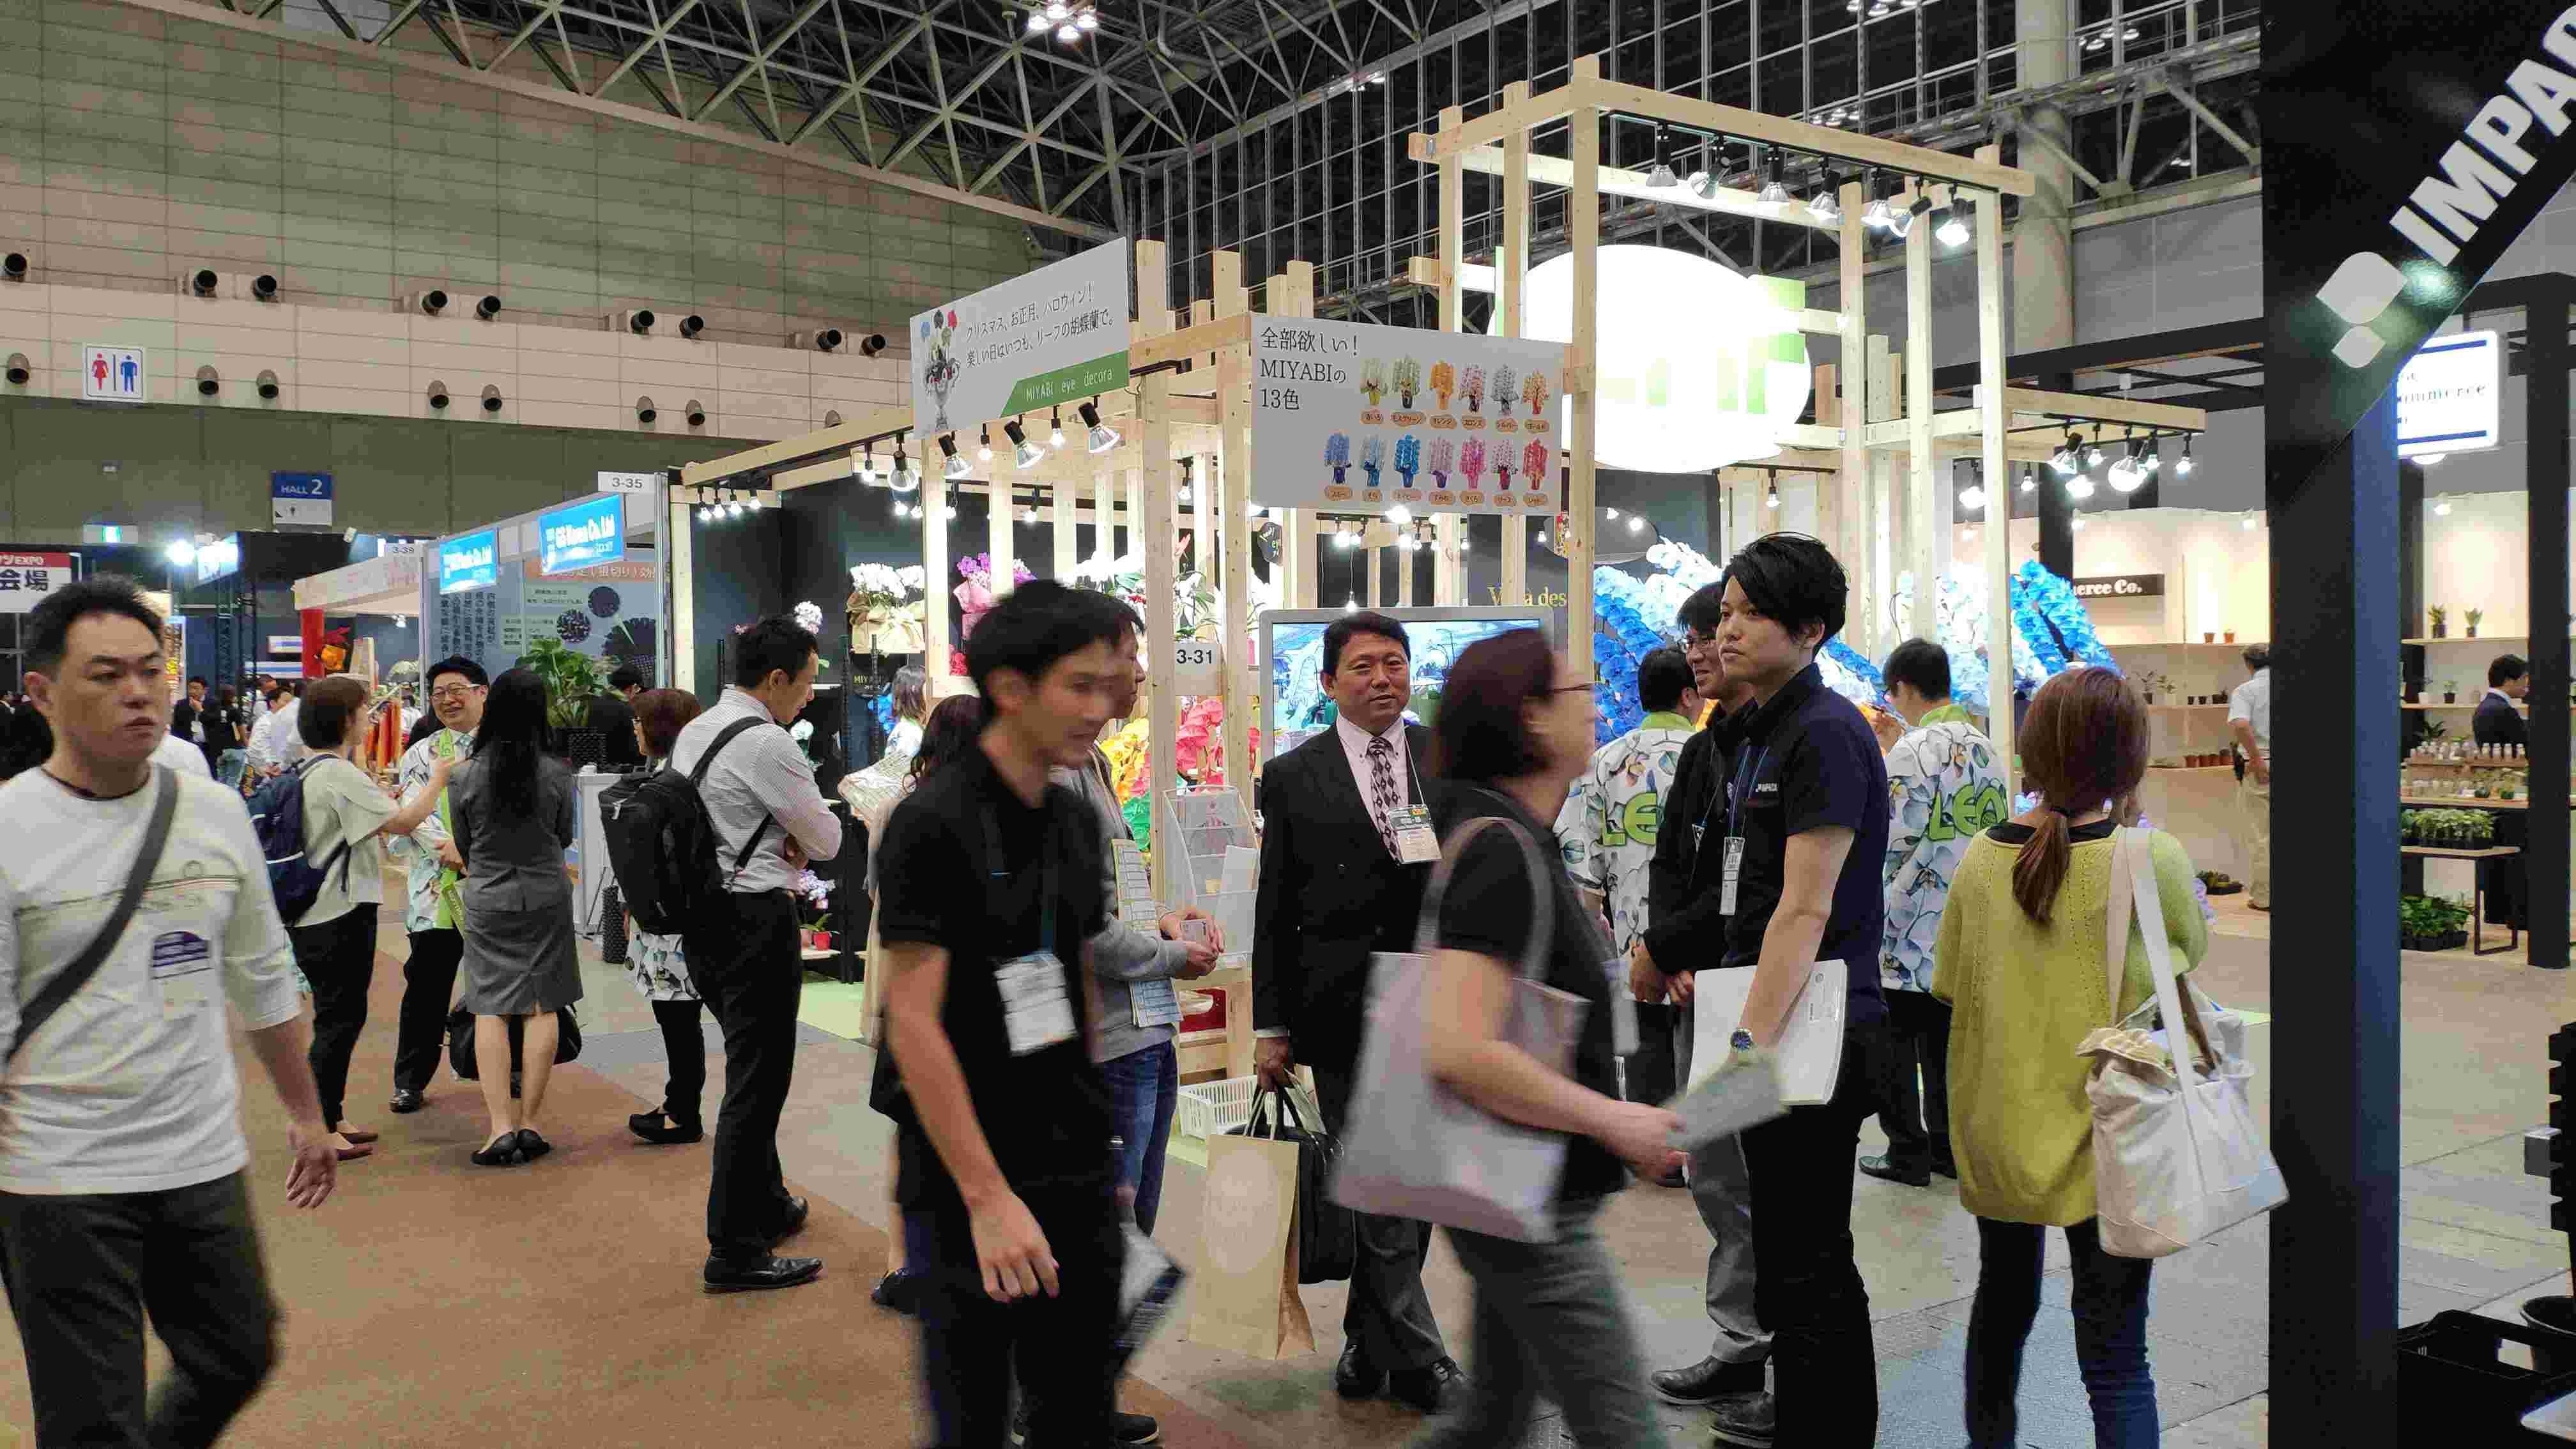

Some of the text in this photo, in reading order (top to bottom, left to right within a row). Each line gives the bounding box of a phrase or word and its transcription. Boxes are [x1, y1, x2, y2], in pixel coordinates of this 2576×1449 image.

[1261, 326, 1358, 356] 全部欲しい！
[1260, 358, 1346, 384] MIYABIの
[1026, 367, 1113, 402] MIYABI eye decora
[1261, 388, 1300, 410] 13色
[282, 479, 323, 494] HALL 2
[611, 477, 643, 489] 3-35
[1176, 649, 1211, 664] 3-31
